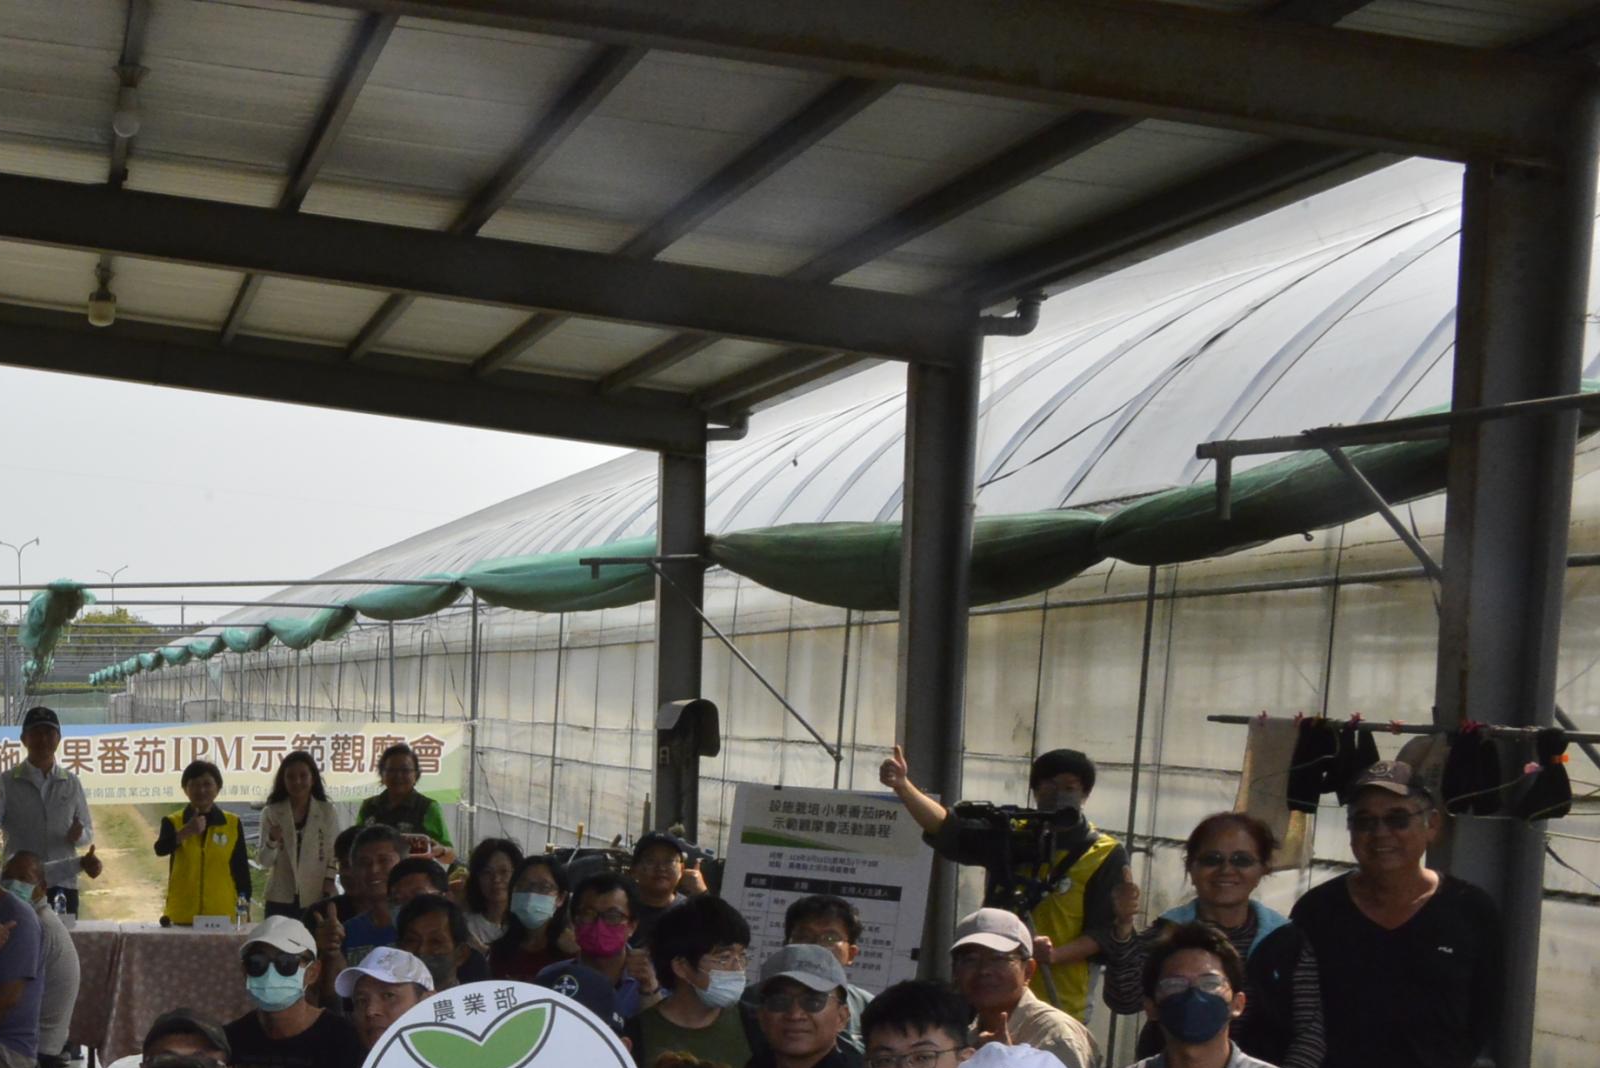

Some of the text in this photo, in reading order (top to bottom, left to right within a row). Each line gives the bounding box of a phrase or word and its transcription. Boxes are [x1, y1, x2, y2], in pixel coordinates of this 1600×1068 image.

[768, 799, 898, 821] 設施栽培小果番茄IPM
[432, 986, 519, 1024] 農業部
